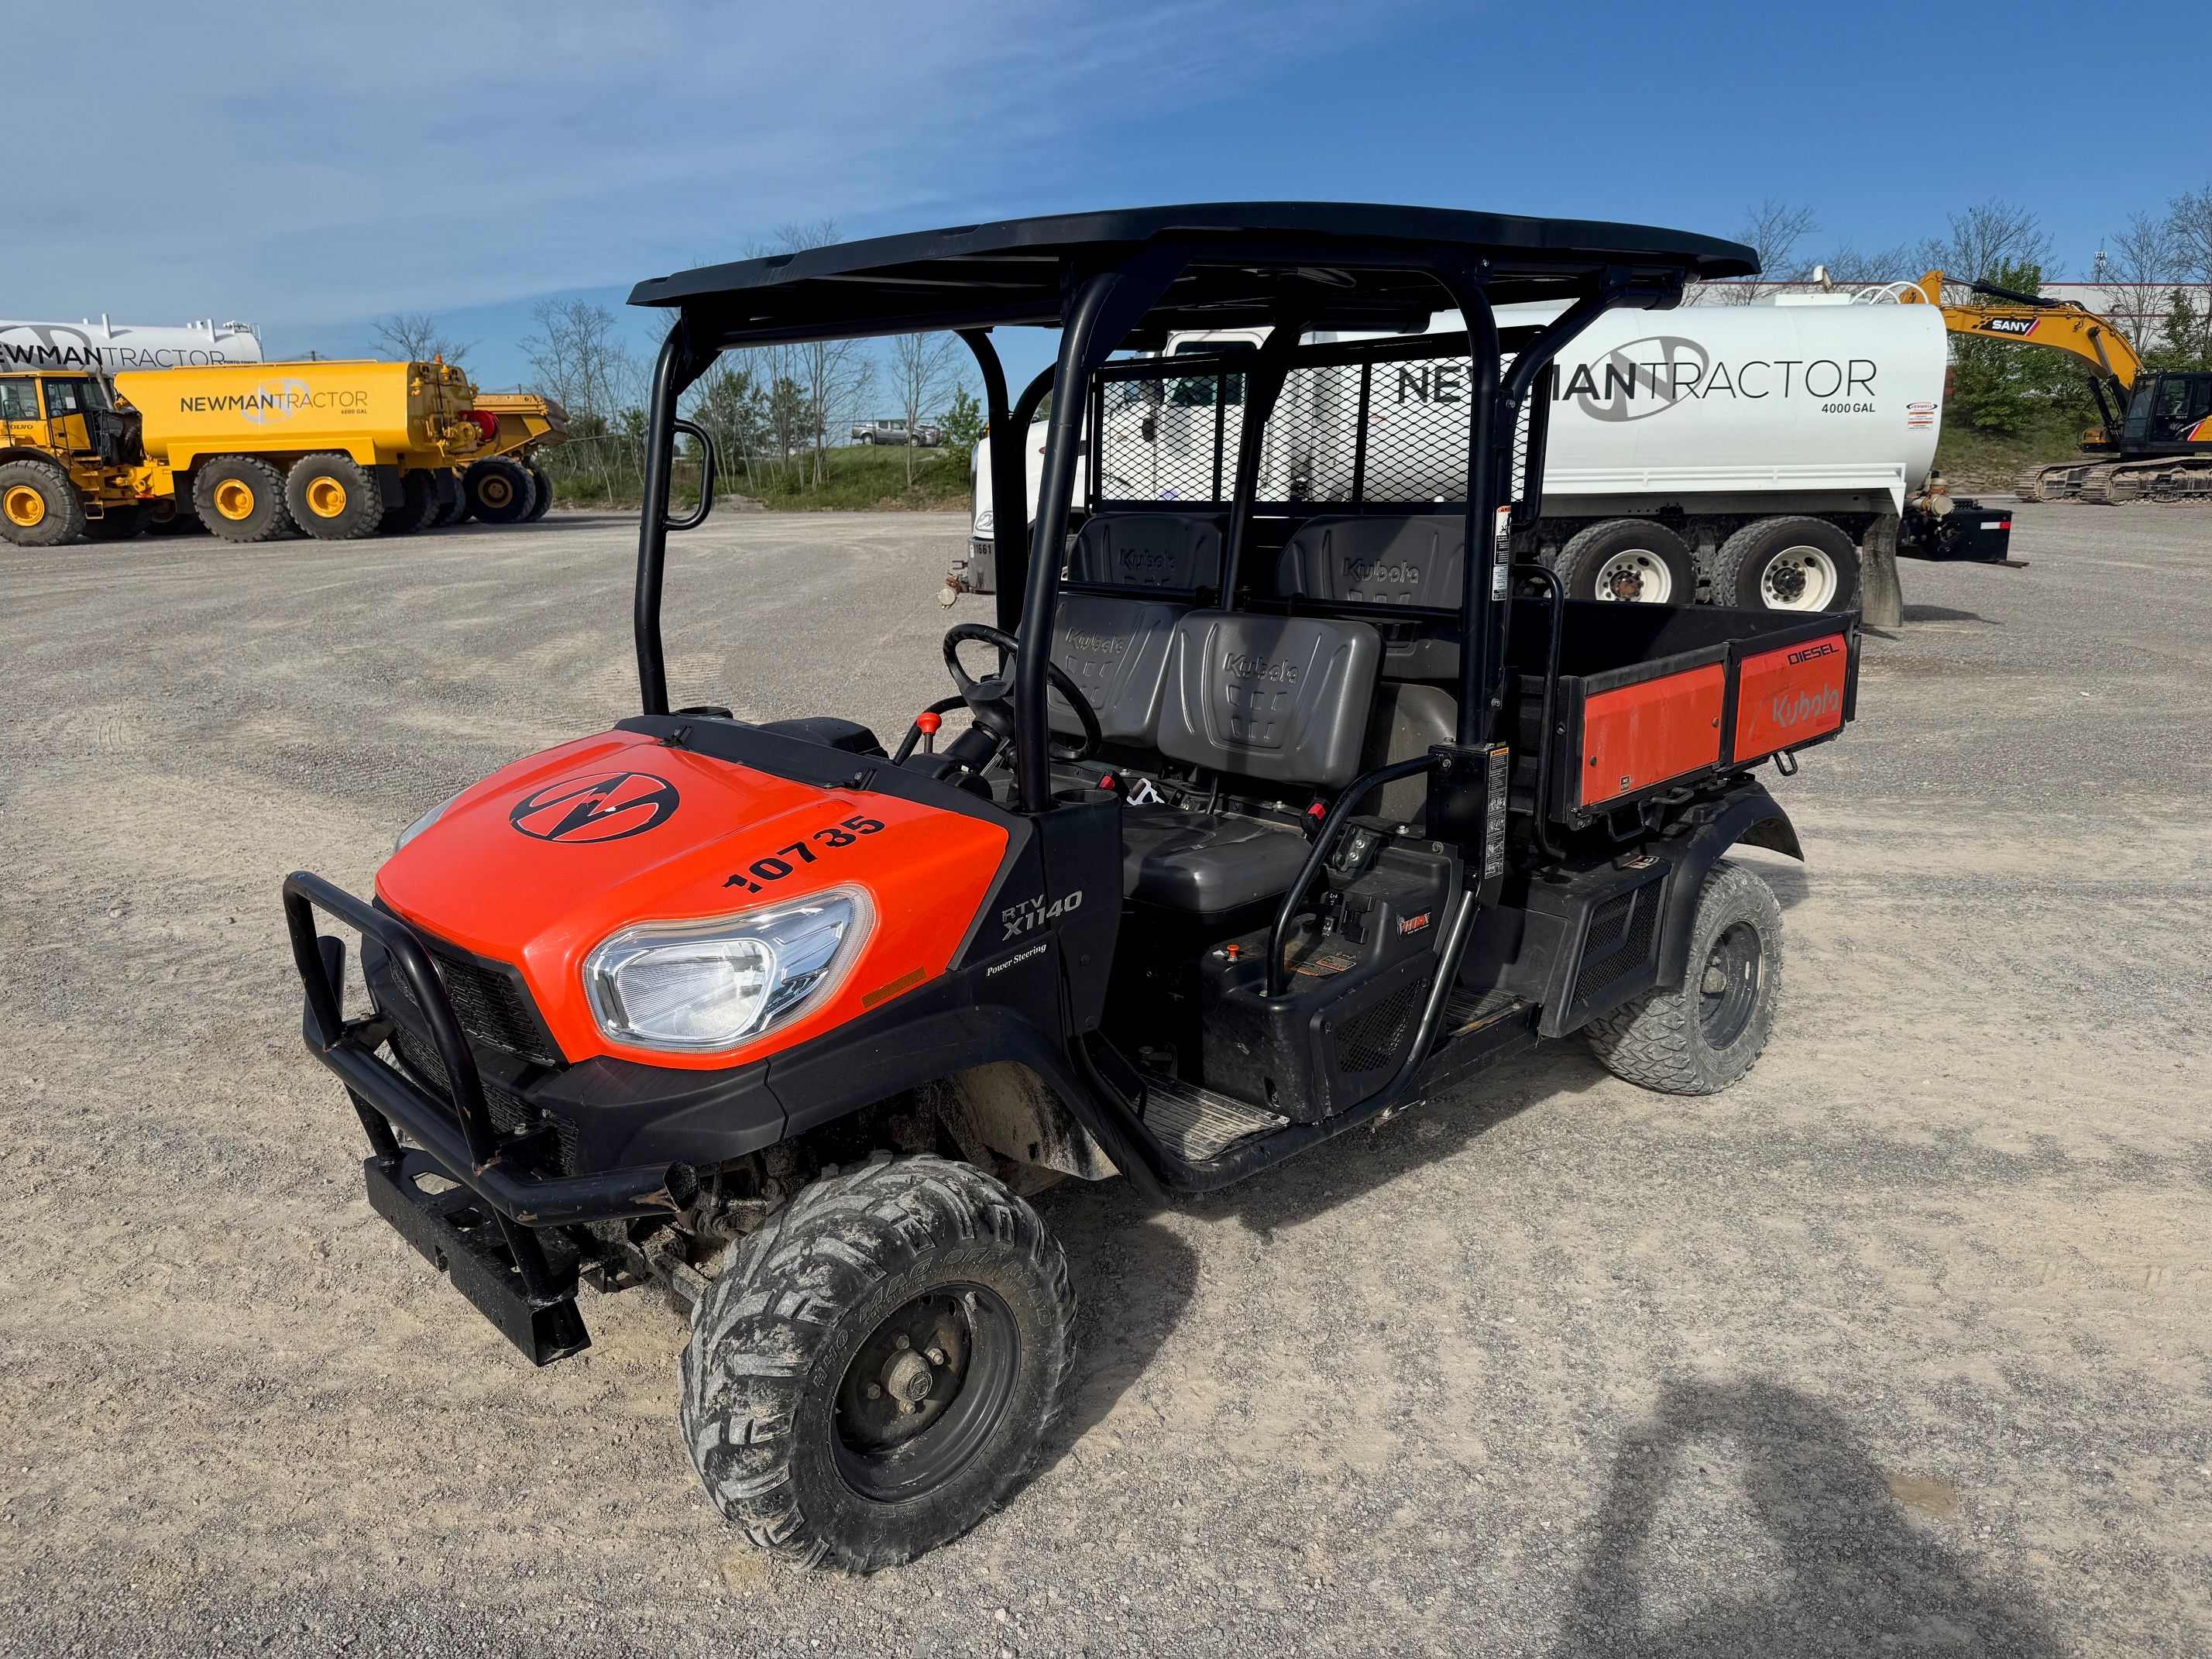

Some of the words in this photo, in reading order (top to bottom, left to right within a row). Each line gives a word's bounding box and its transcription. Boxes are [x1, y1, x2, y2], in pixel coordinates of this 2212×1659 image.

[1991, 319, 2030, 332] SANY
[1822, 403, 1851, 414] 4000
[1852, 403, 1876, 413] GAL
[1342, 557, 1420, 586] Kubota
[1065, 627, 1124, 654] Kubota
[1787, 643, 1840, 665] DIESEL
[1222, 652, 1300, 685] Kubota
[1772, 682, 1839, 728] Kubota
[722, 815, 886, 894] 10735
[1001, 894, 1044, 922] RTV
[1001, 890, 1083, 941] X1140
[987, 959, 1013, 977] Power
[1013, 943, 1047, 964] Steering
